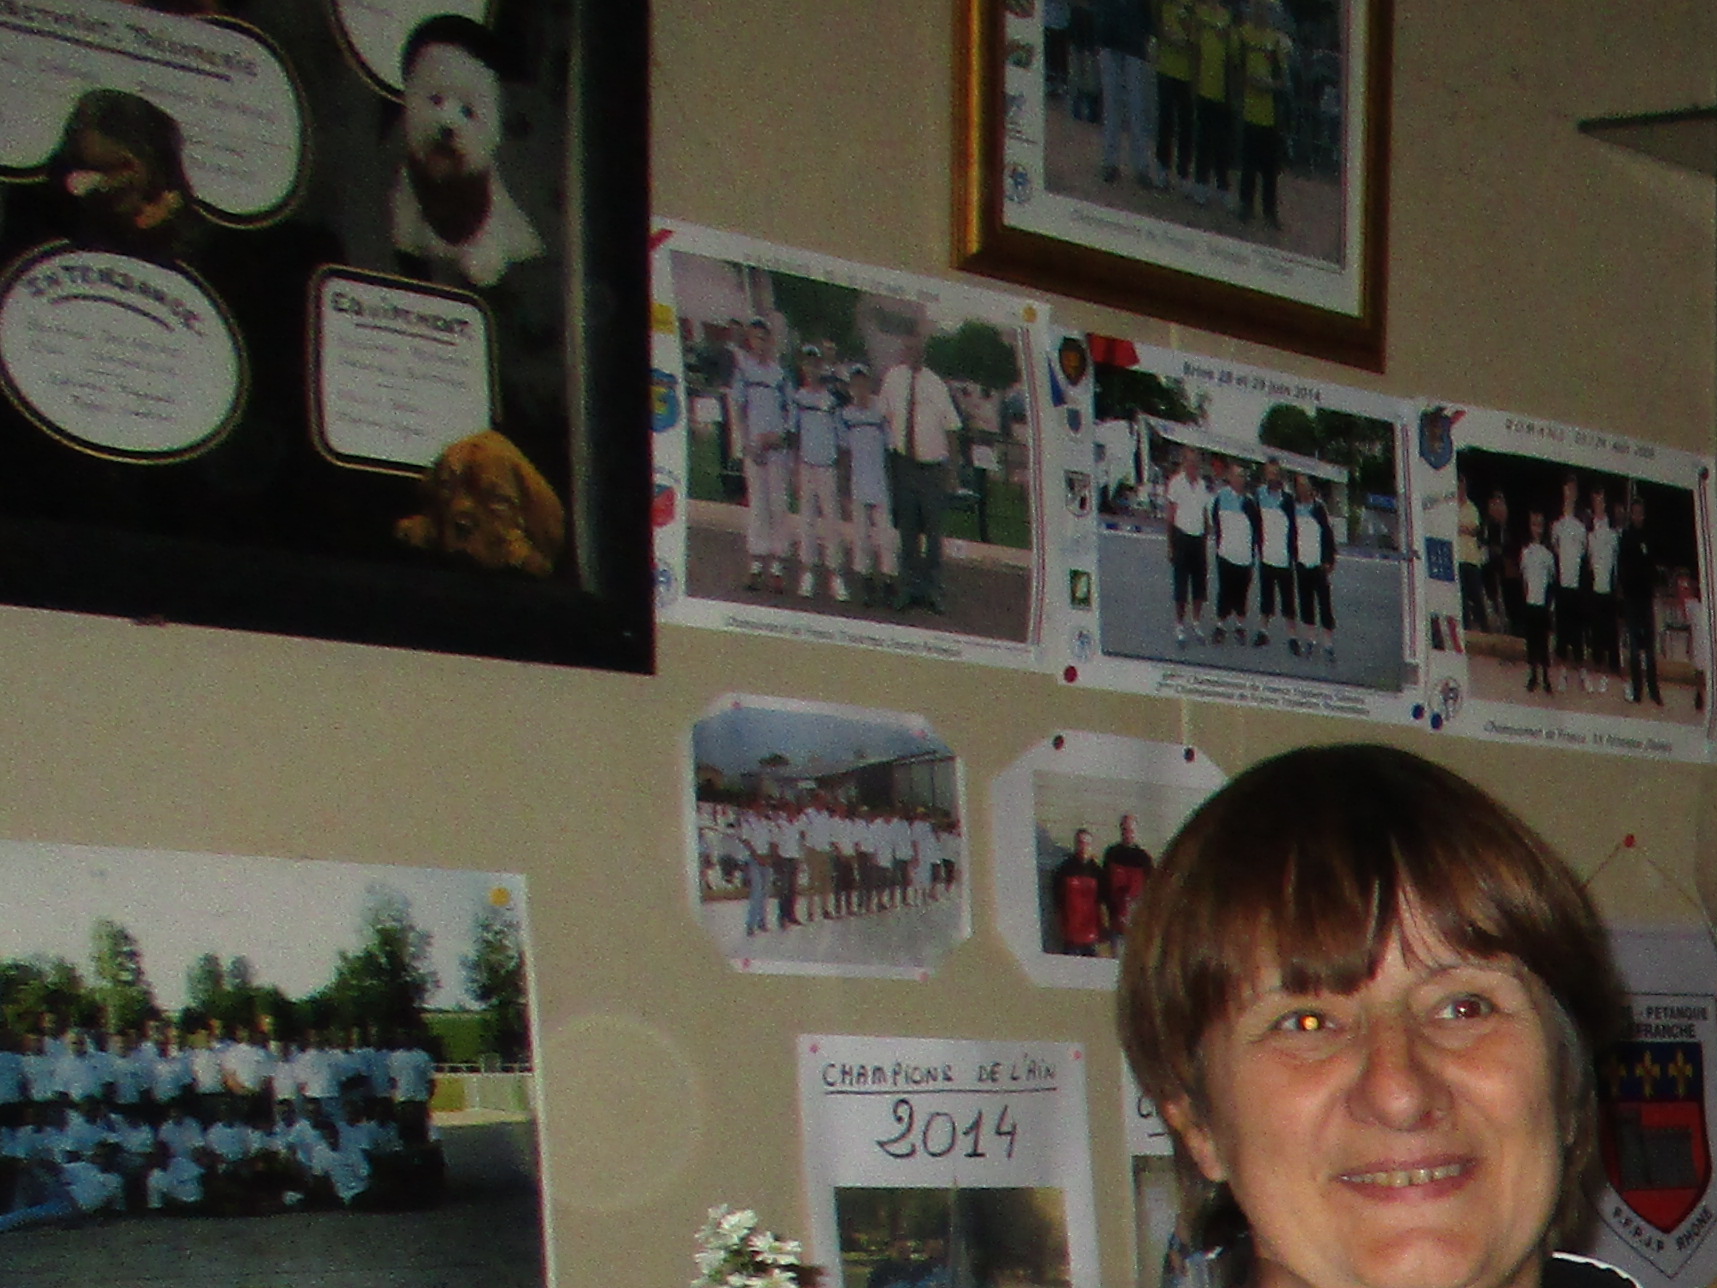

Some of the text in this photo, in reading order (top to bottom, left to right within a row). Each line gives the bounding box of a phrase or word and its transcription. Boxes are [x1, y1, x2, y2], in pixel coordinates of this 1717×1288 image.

[977, 1061, 1001, 1084] DE
[875, 1097, 1018, 1160] 2014
[1676, 1204, 1713, 1252] RHONE
